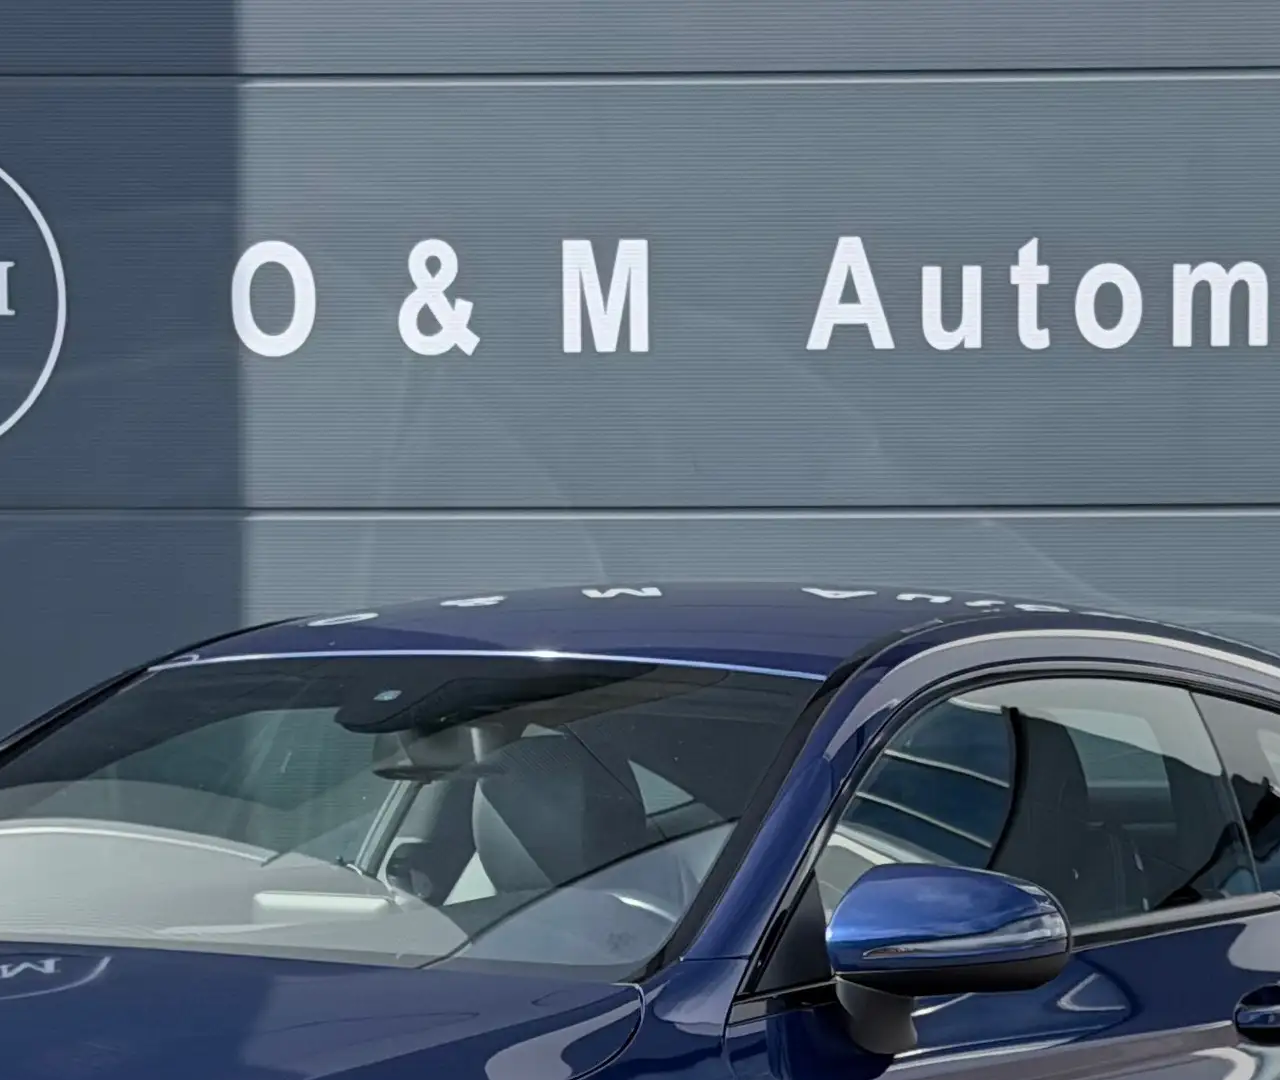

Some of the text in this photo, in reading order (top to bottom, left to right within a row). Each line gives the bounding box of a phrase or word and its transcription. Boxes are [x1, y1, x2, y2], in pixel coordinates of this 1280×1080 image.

[232, 240, 316, 357] O
[398, 238, 481, 356] &
[562, 239, 649, 353] M
